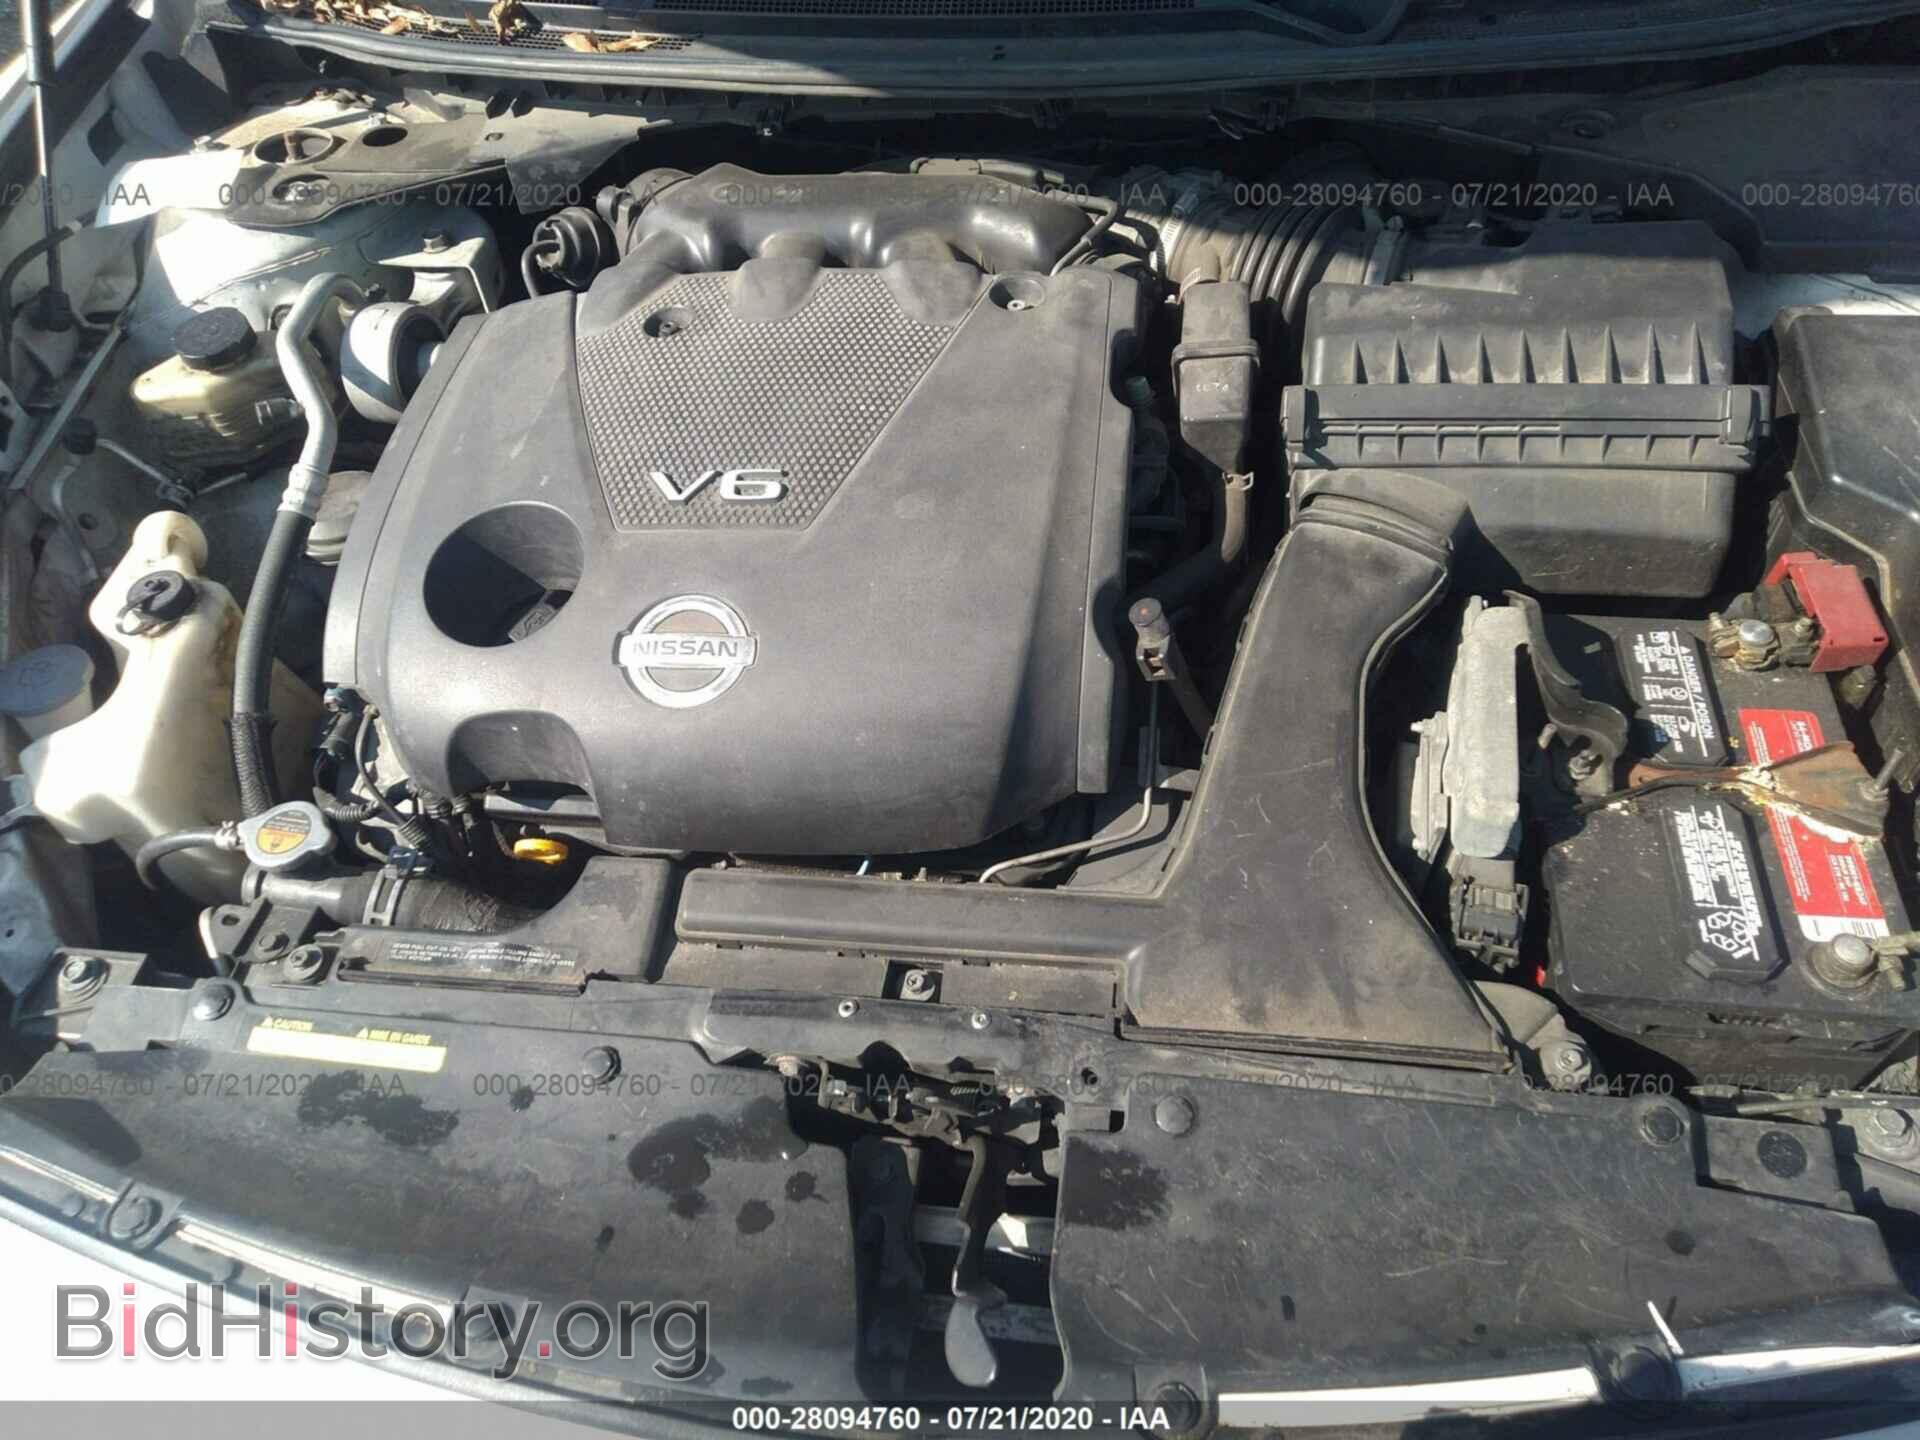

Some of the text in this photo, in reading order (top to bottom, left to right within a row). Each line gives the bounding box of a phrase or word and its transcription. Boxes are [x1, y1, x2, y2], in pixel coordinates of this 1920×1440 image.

[650, 468, 788, 502] V6
[633, 640, 738, 657] NISSAN
[1680, 656, 1702, 692] DANGER
[1695, 702, 1715, 738] POISON
